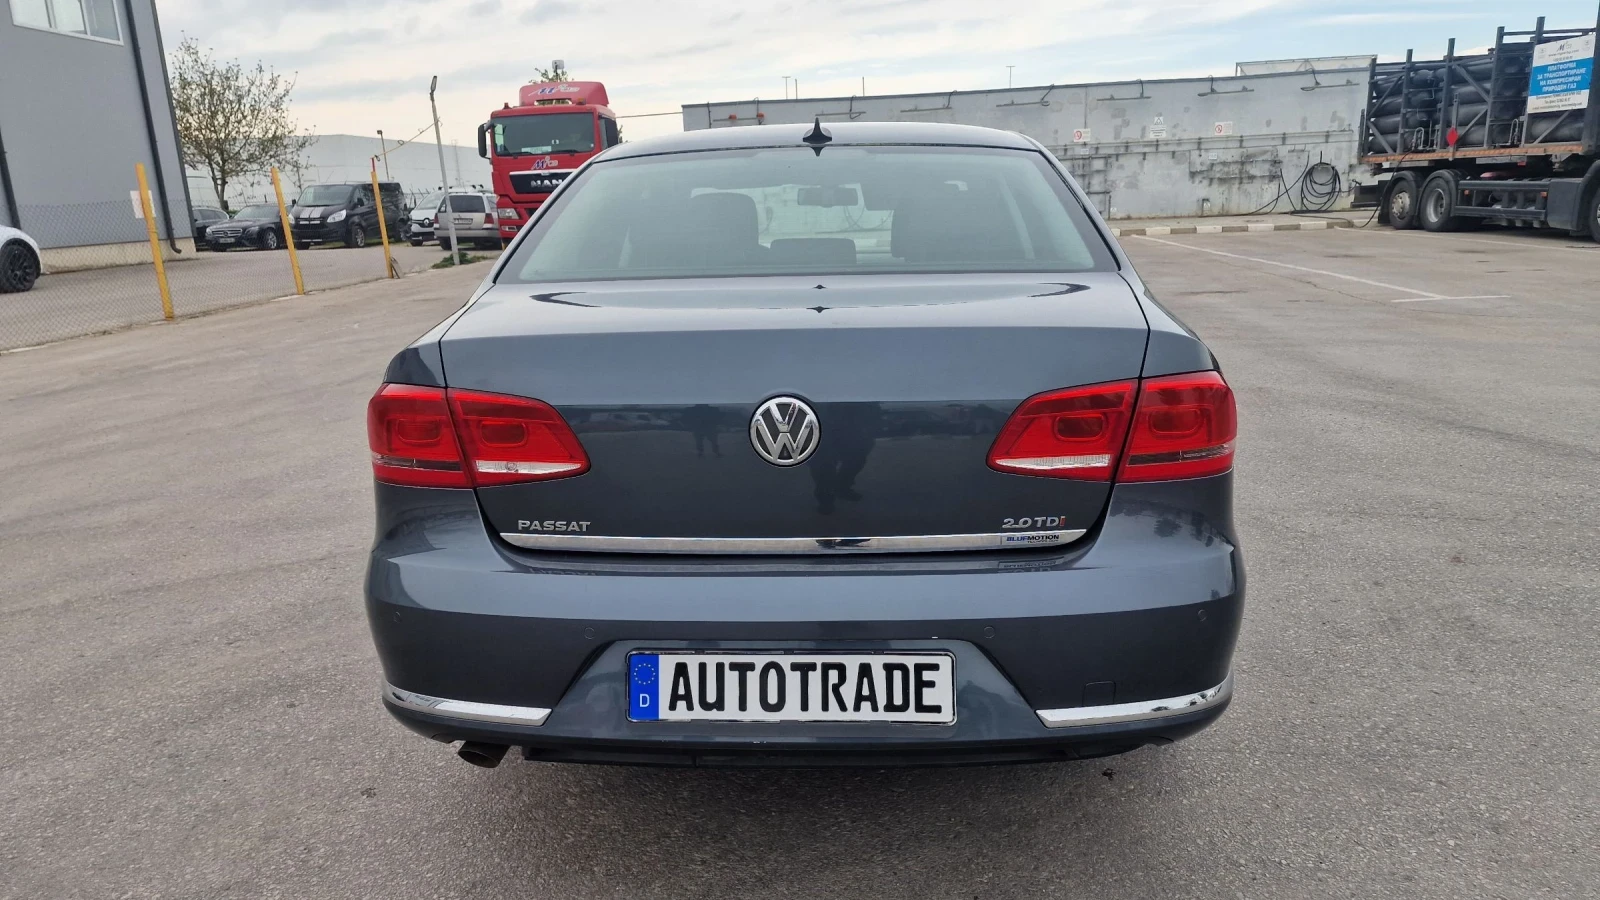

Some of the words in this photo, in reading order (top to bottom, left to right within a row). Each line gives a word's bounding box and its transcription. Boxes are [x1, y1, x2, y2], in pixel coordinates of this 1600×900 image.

[531, 179, 564, 187] MAN
[518, 520, 591, 532] PASSAT
[1002, 517, 1032, 529] 2.0
[1006, 534, 1060, 542] BLUEMOTION
[668, 660, 943, 715] AUTOTRADE
[639, 693, 650, 708] D
